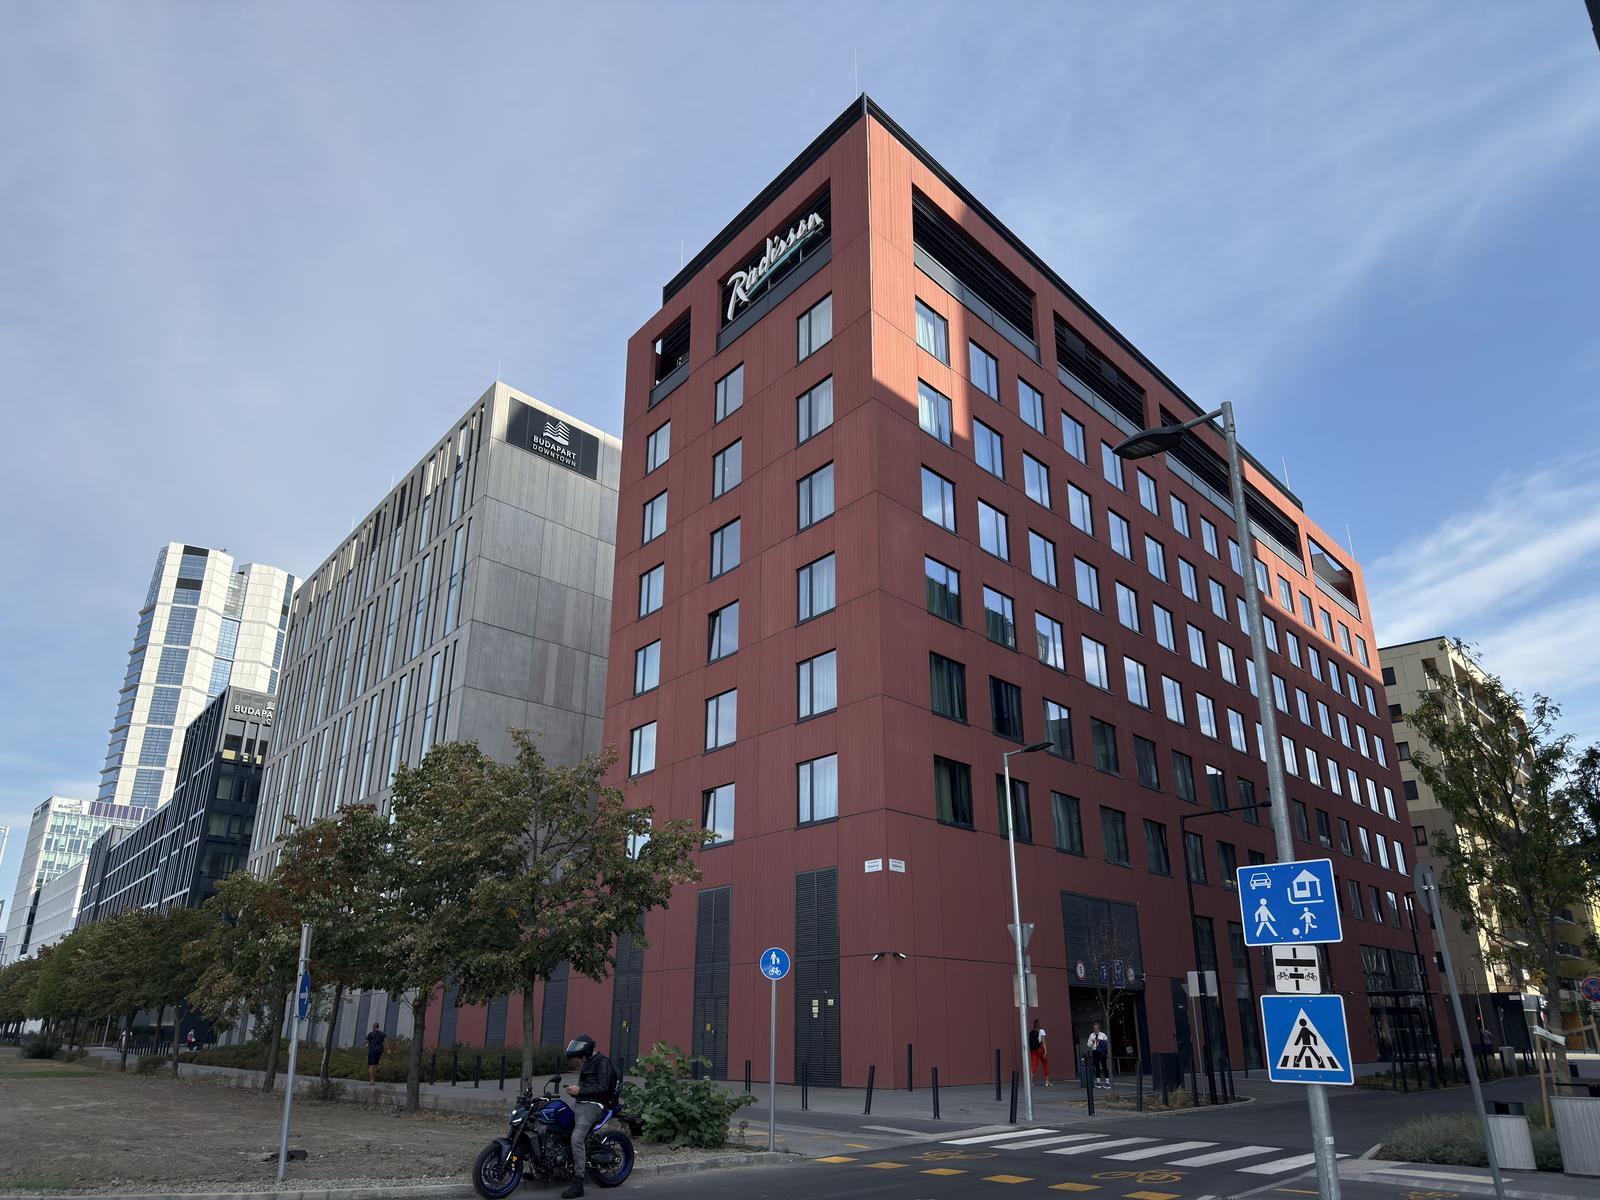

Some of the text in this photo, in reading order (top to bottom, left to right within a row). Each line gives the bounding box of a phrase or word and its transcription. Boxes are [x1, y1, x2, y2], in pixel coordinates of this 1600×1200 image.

[727, 212, 824, 320] Radisson
[532, 443, 576, 467] DOWNTOWN
[533, 435, 577, 459] BUDAPART
[234, 704, 273, 719] BUDAPA
